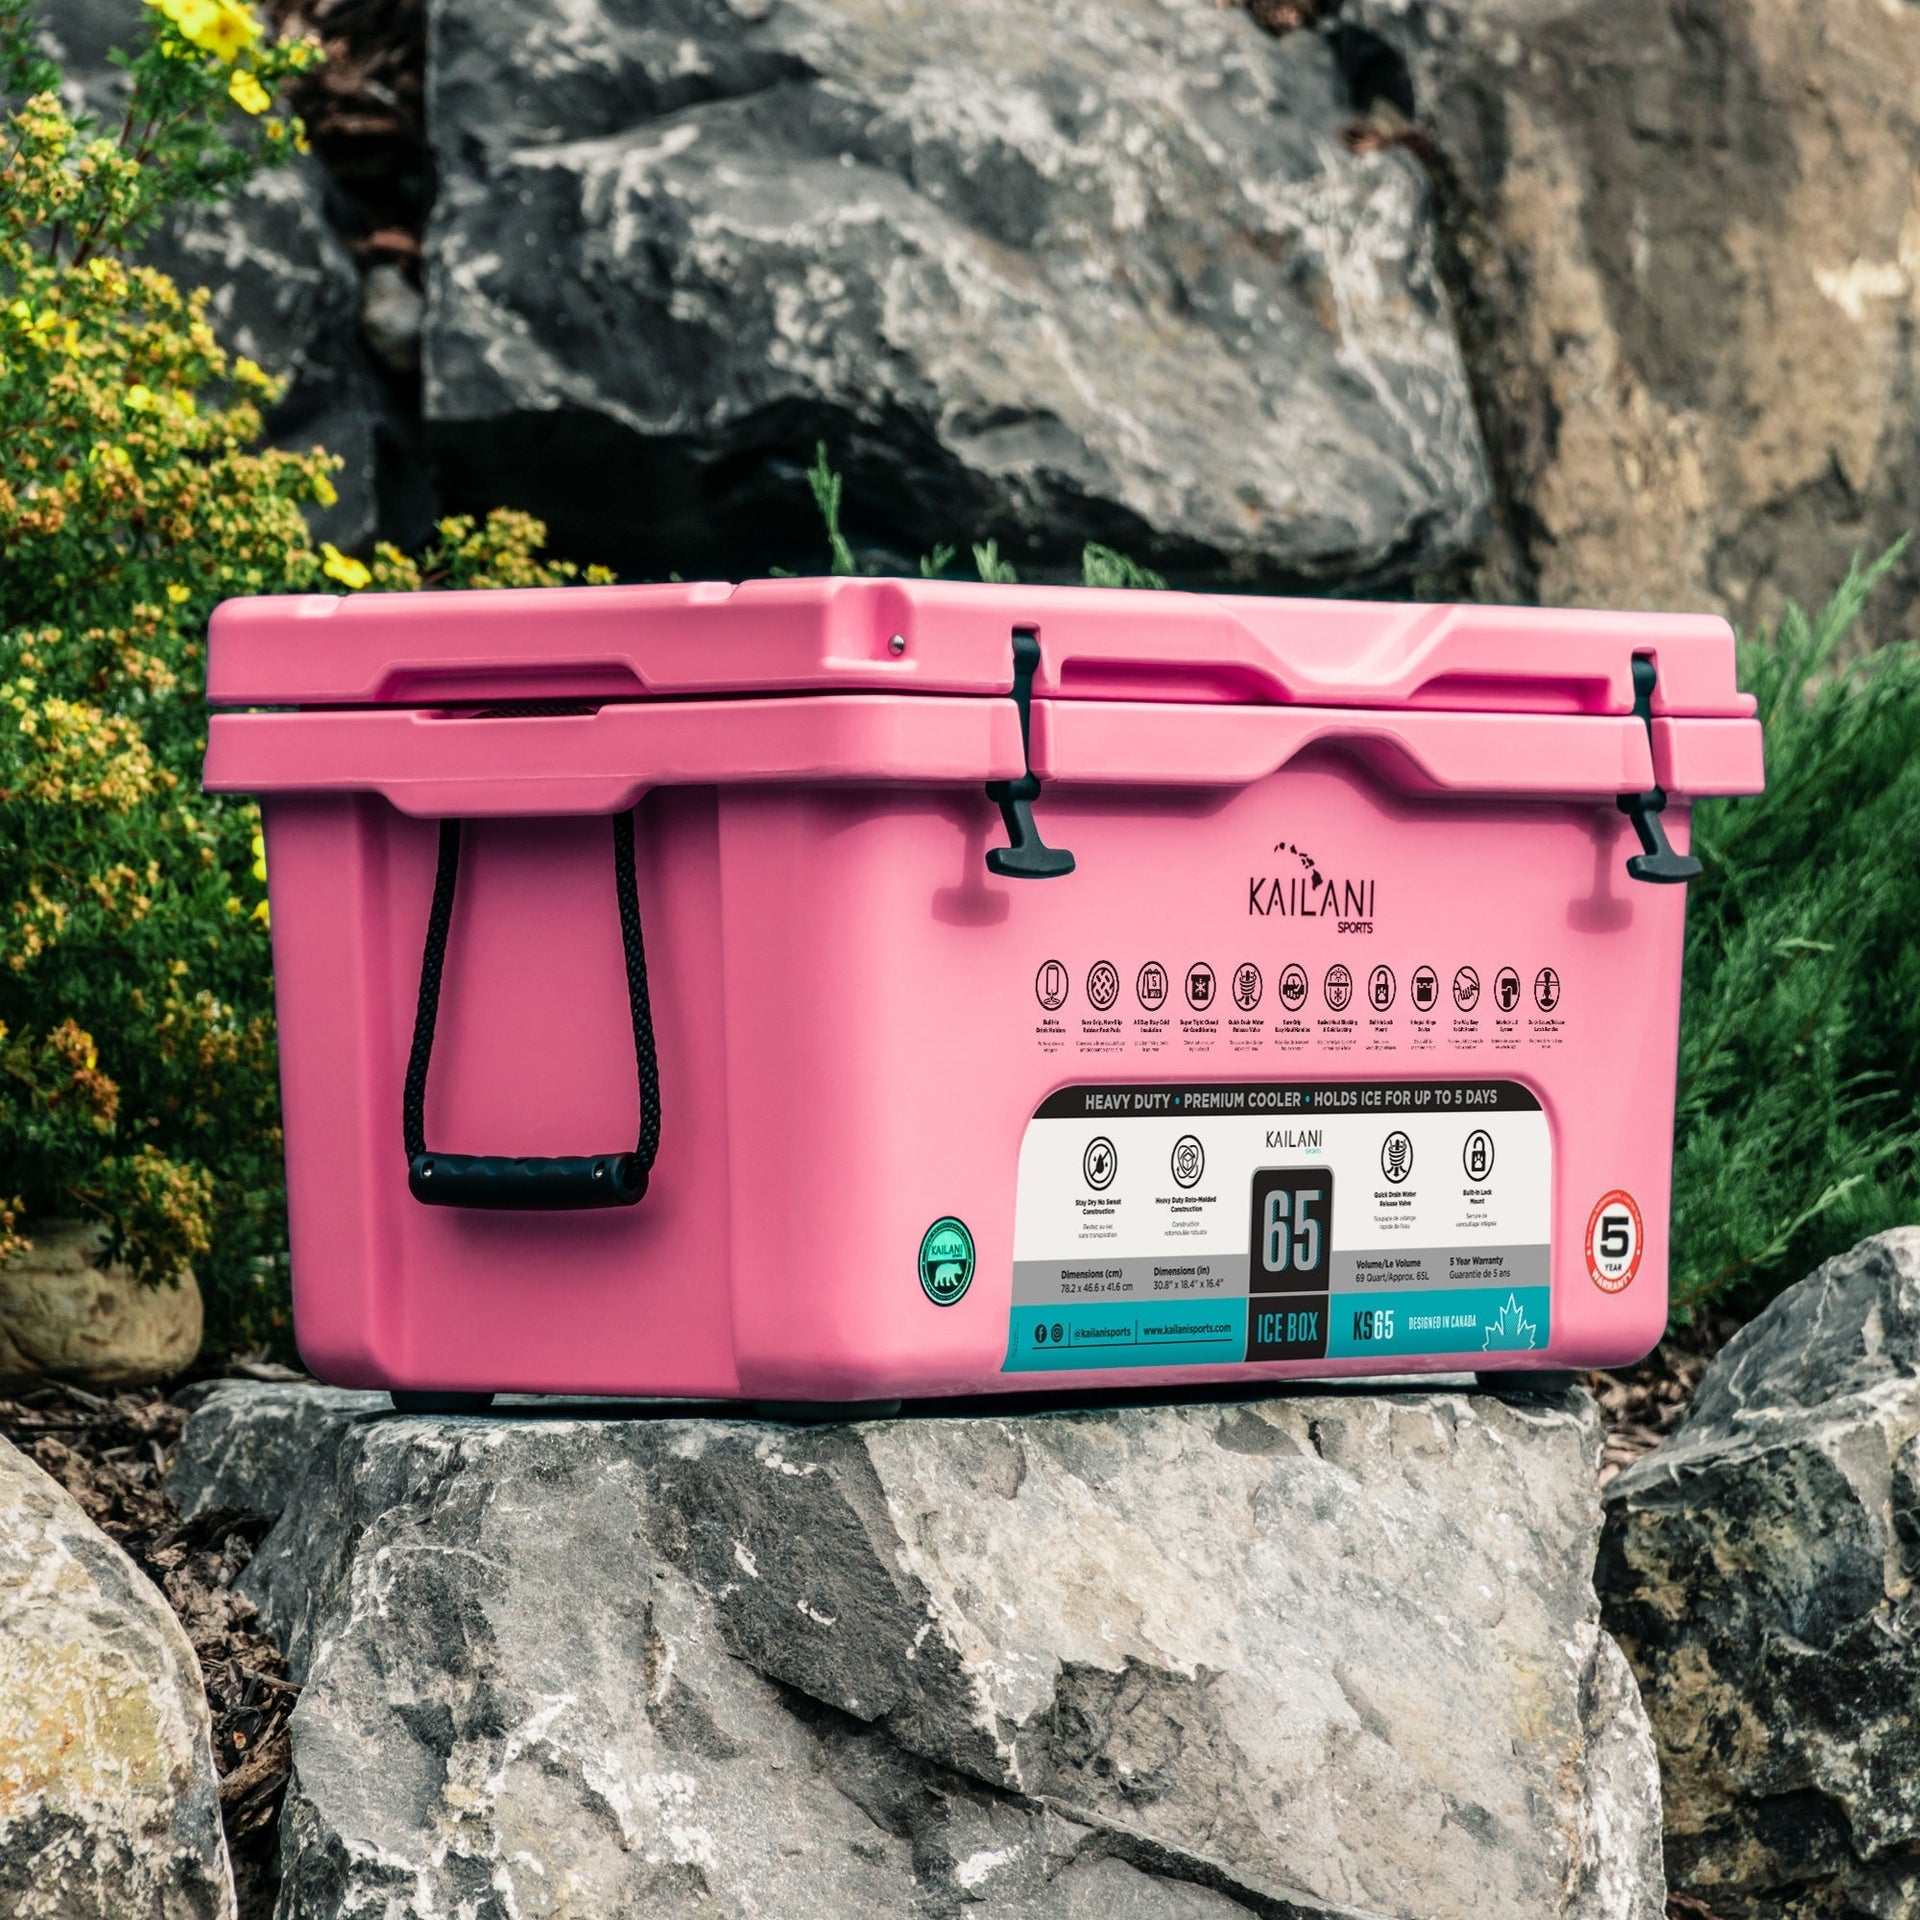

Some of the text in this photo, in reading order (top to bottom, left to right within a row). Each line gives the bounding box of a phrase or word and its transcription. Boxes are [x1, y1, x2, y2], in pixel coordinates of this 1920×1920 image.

[1249, 877, 1374, 918] KAILANI
[1337, 921, 1373, 934] SPORTS
[1085, 1089, 1497, 1110] HEAVY DUTY PREMIUM COOLER HOLDS ICE FOR UP TO 5 DAYS
[1266, 1130, 1322, 1148] KAILANI
[1155, 1197, 1171, 1205] Heavy
[1172, 1196, 1184, 1204] Duty
[1374, 1191, 1388, 1199] Quick
[1075, 1199, 1086, 1207] Stay
[1088, 1199, 1097, 1207] Dry
[1106, 1198, 1122, 1206] Sweat
[1170, 1205, 1202, 1213] Construction
[1262, 1189, 1322, 1272] 65
[1600, 1216, 1629, 1258] 5
[931, 1244, 963, 1256] KAILANI
[1356, 1258, 1421, 1270] Volume/Le Volume
[1450, 1256, 1504, 1266] 5 Year Warranty
[1604, 1263, 1622, 1272] YEAR
[1061, 1268, 1123, 1280] Dimensions (cm)
[1154, 1265, 1210, 1276] Dimensions (in)
[1449, 1269, 1510, 1279] Guarantie de 5 ans
[1355, 1271, 1429, 1284] 69 Quart/Approx. 65L
[1592, 1268, 1632, 1291] WARRANTY
[1061, 1284, 1075, 1293] 78.2
[1083, 1283, 1099, 1292] 46.6
[1106, 1282, 1120, 1291] 41.6
[1122, 1283, 1133, 1291] cm
[1257, 1312, 1318, 1343] ICE BOX
[1353, 1309, 1394, 1341] KS65
[1408, 1314, 1477, 1330] DESIGNED IN CANADA
[1074, 1326, 1131, 1340] @kailanisports
[1143, 1323, 1231, 1336] www.kailanisports.com
